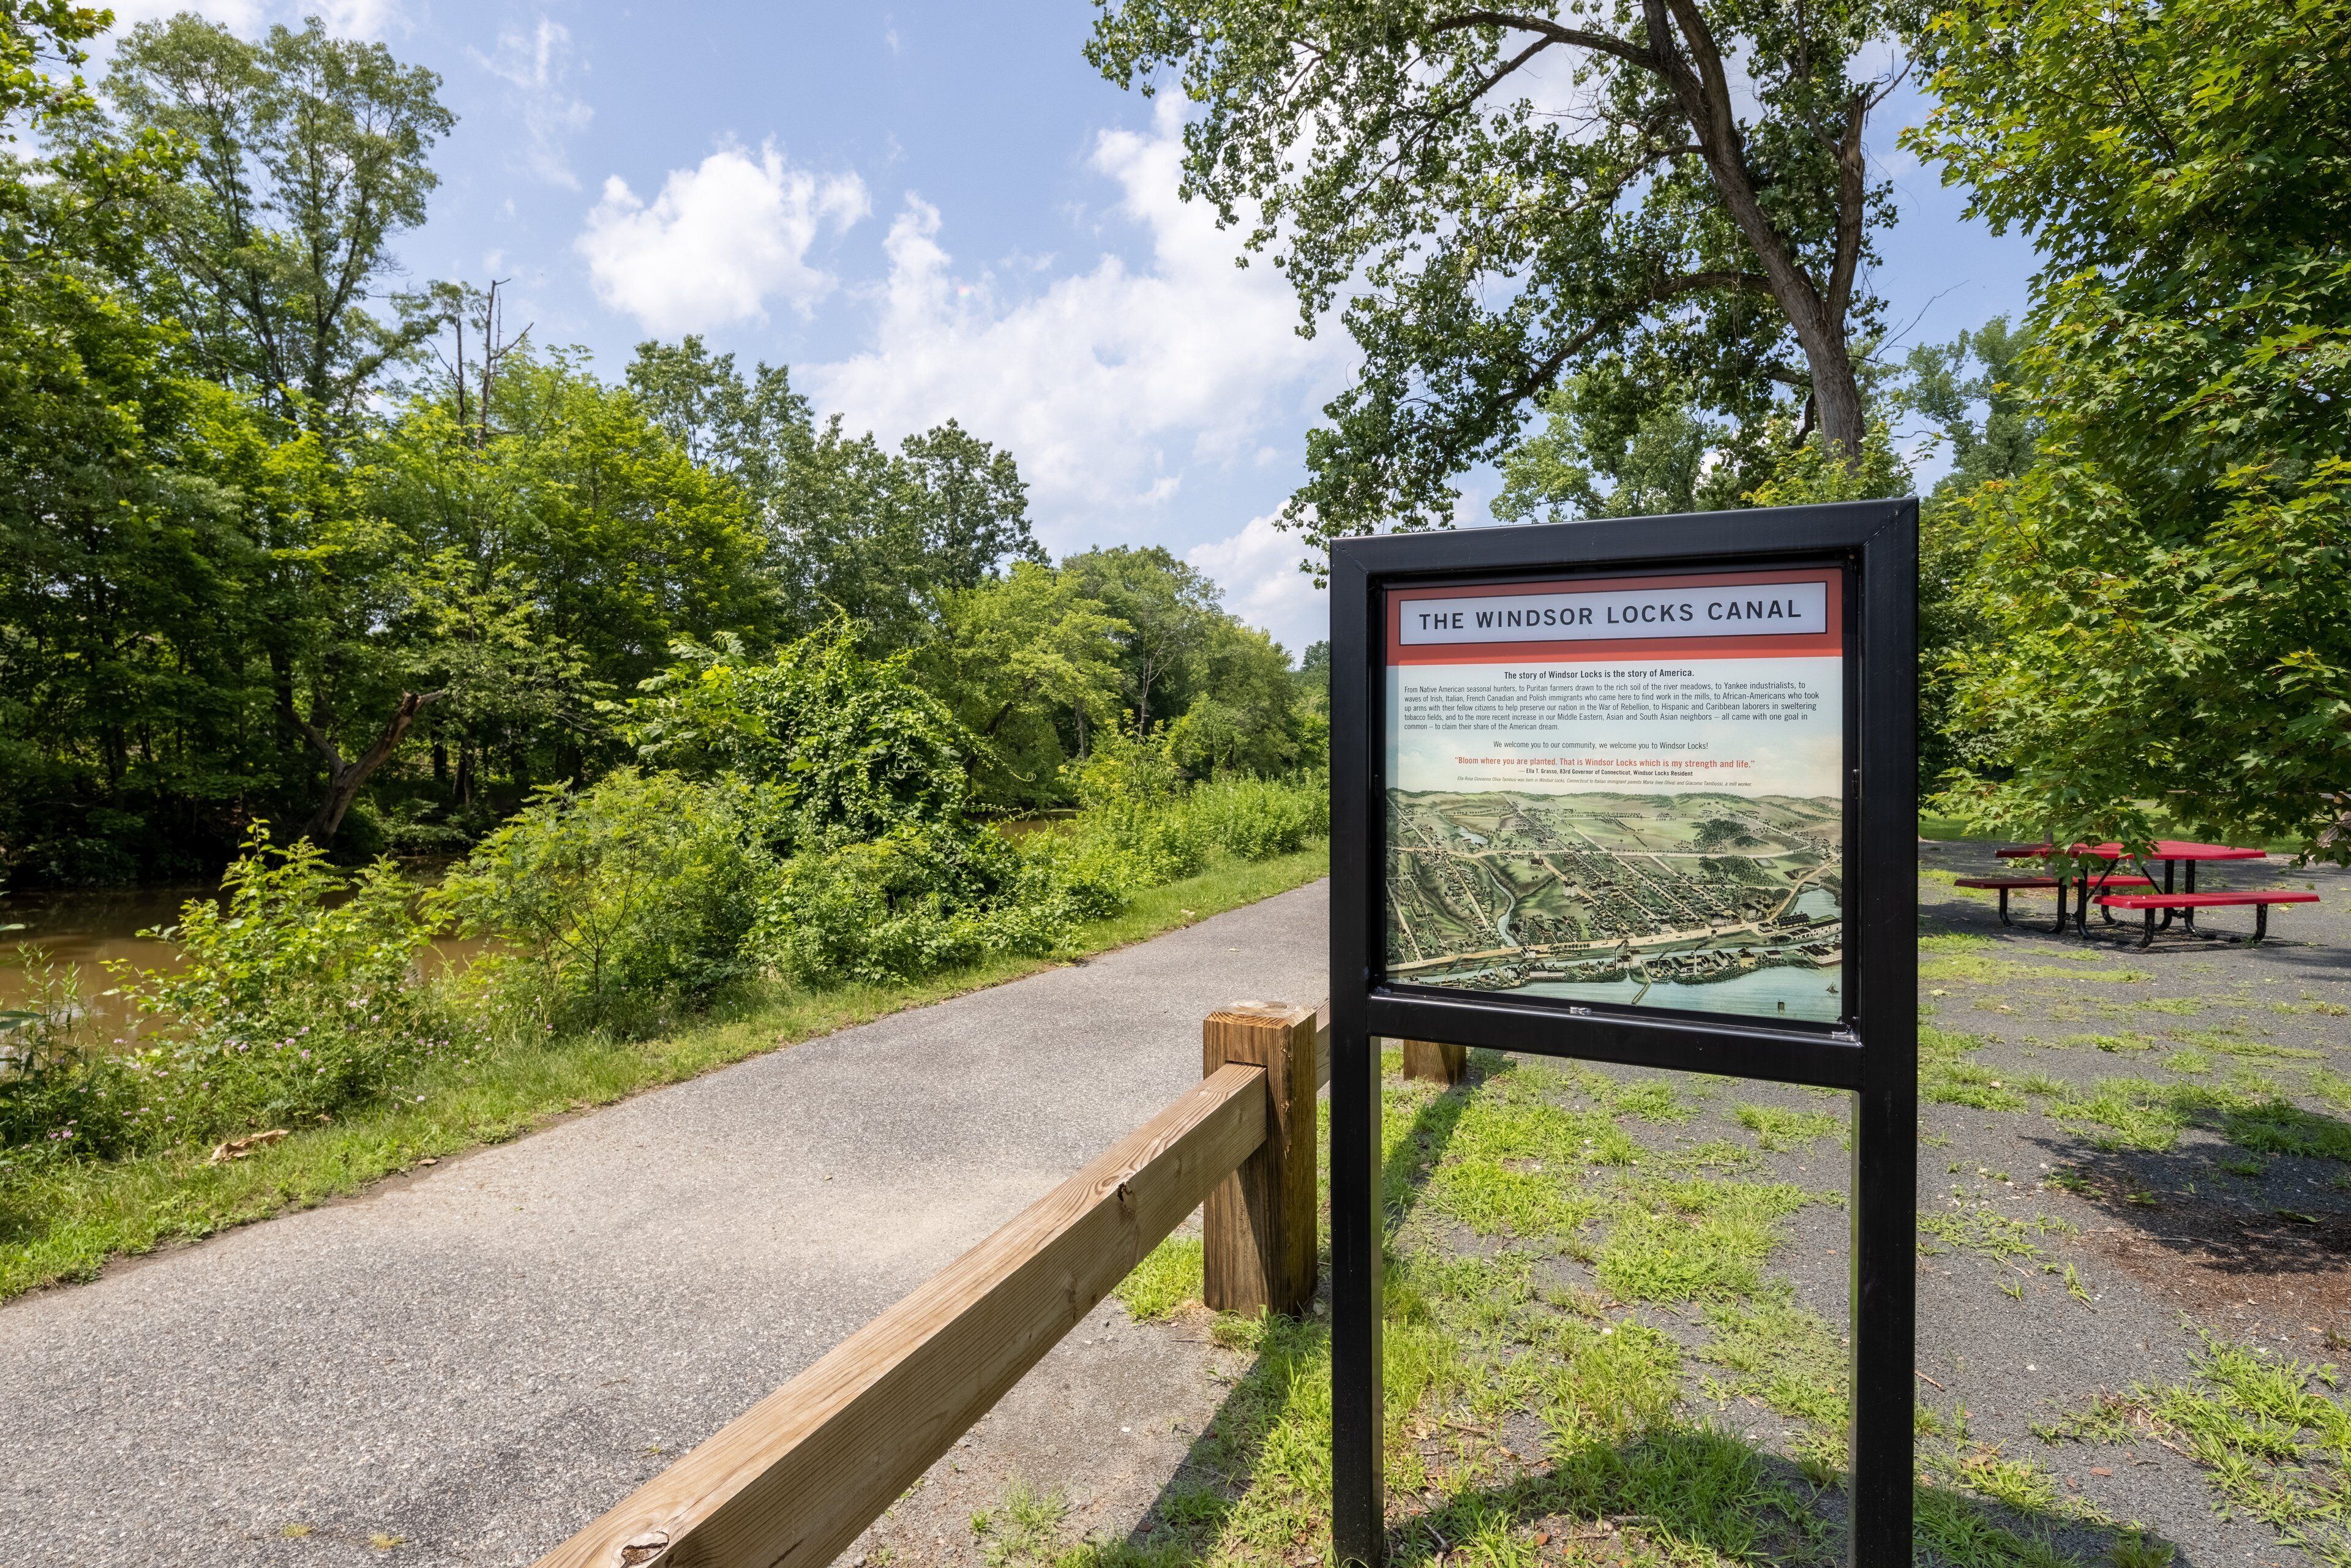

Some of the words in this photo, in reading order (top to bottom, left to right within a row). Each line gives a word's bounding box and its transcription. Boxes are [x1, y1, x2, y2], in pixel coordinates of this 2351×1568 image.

[1419, 612, 1463, 630] THE
[1475, 607, 1592, 628] WINDSOR
[1607, 603, 1693, 624] LOCKS
[1708, 599, 1801, 620] CANAL
[1519, 672, 1537, 680] story
[1539, 670, 1547, 679] of
[1627, 670, 1647, 678] story
[1659, 668, 1694, 677] America.
[1680, 682, 1713, 691] meadows,
[1750, 681, 1796, 689] industrialists,
[1548, 694, 1583, 702] immigrants
[1694, 692, 1712, 701] mills,
[1722, 691, 1785, 700] African-Americans
[1505, 703, 1518, 712] help
[1662, 702, 1689, 711] Hispanic
[1742, 702, 1769, 710] laborers
[1780, 702, 1817, 711] sweltering
[1579, 713, 1604, 721] Eastern,
[1680, 713, 1712, 722] neighbors
[1784, 712, 1798, 722] goal
[1562, 741, 1597, 750] community,
[1530, 757, 1558, 766] planted.
[1684, 759, 1717, 769] strength
